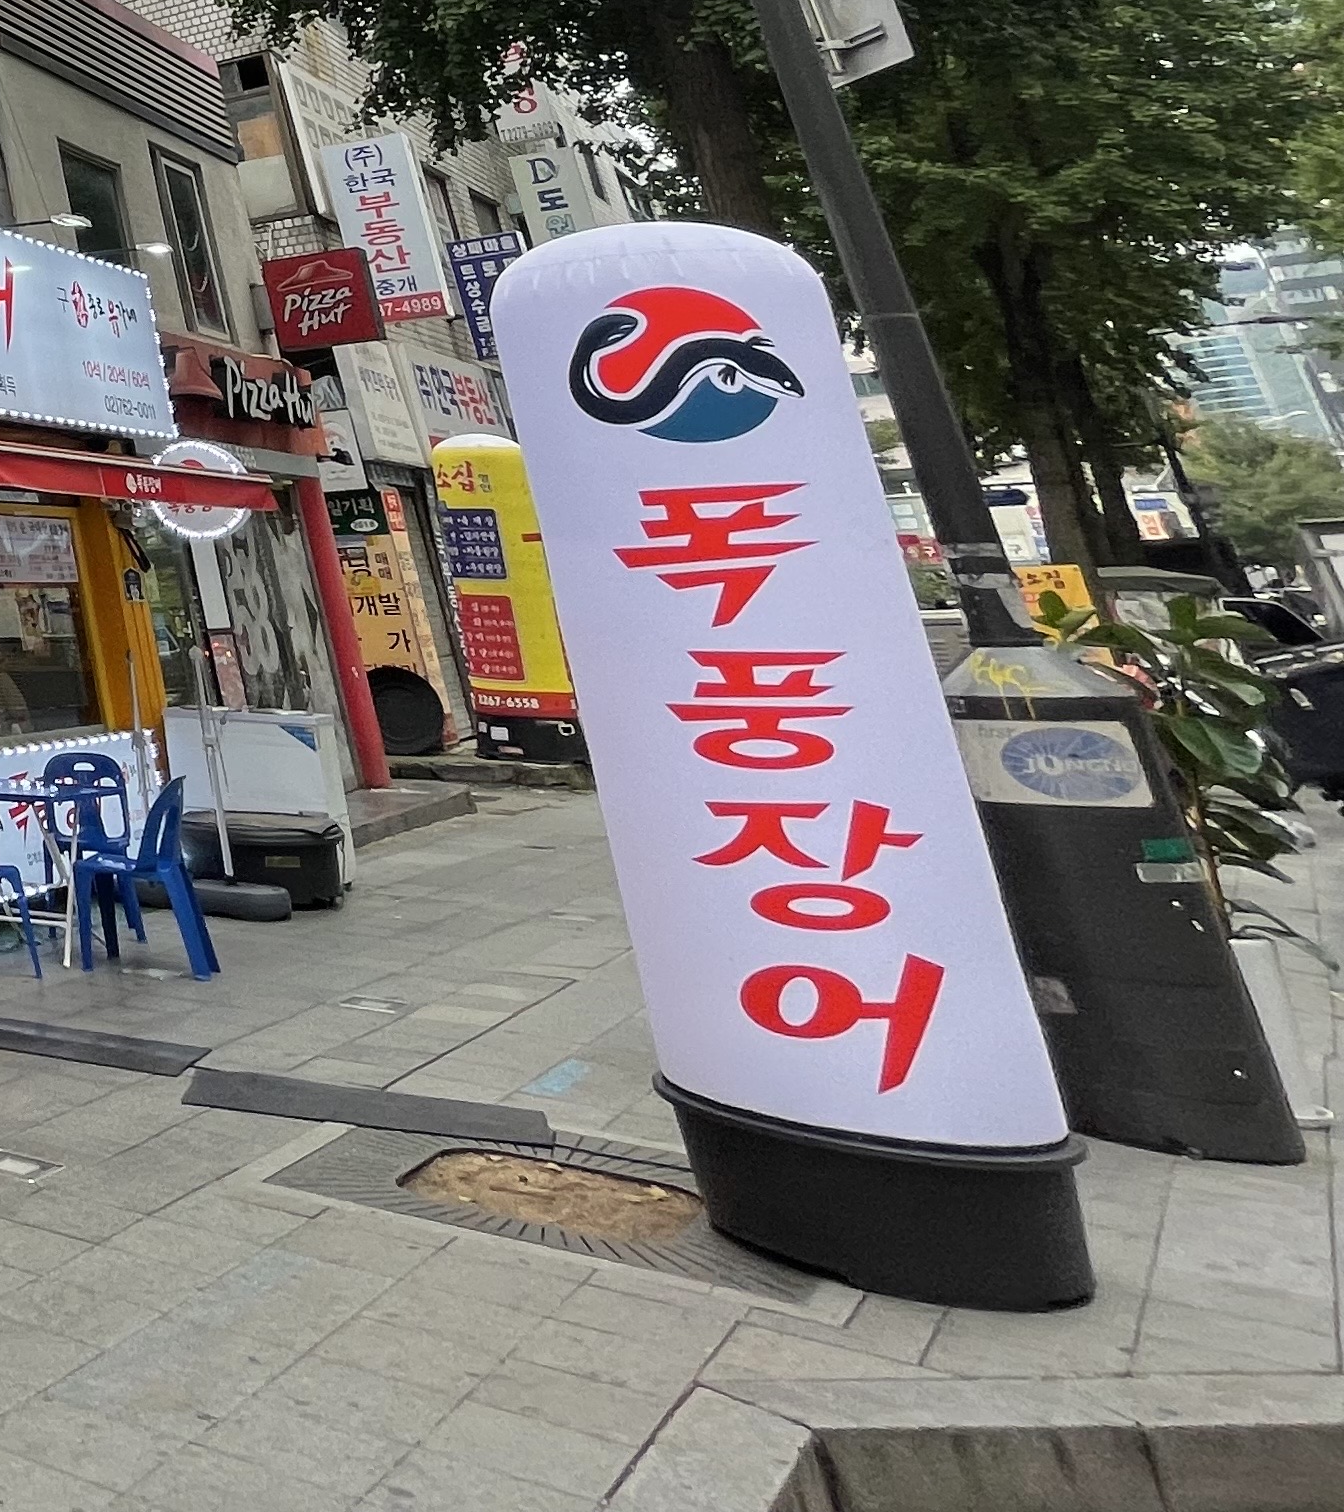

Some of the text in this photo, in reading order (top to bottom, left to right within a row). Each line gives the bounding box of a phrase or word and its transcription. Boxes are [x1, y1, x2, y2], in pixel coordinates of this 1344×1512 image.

[344, 143, 384, 172] (주)
[342, 167, 398, 194] 한국
[355, 191, 412, 274] 부동산
[376, 275, 418, 296] 중개
[284, 286, 353, 324] Pizza
[298, 302, 352, 337] Hut
[223, 356, 284, 423] Pizza
[613, 482, 945, 1095] 폭풍장어
